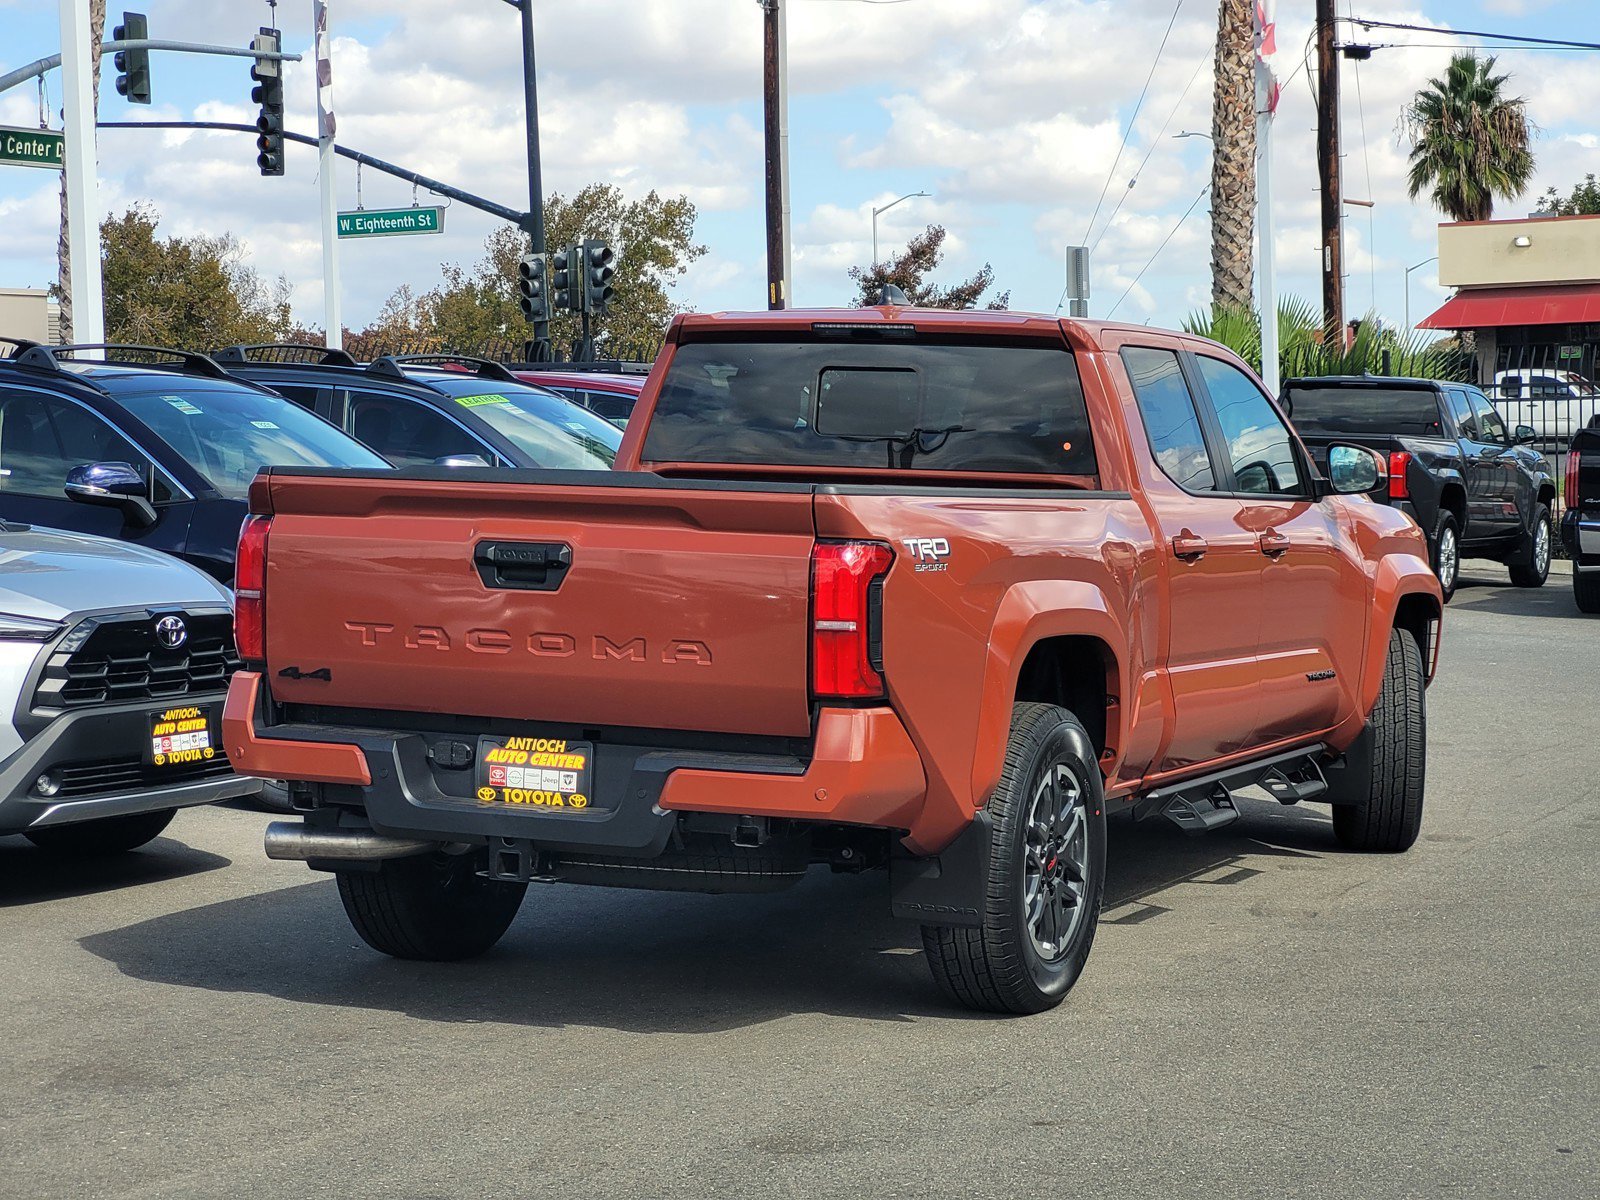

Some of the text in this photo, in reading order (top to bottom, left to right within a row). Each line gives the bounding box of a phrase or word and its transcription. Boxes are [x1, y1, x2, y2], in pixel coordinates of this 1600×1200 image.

[7, 136, 51, 157] Center
[56, 141, 64, 158] D
[340, 214, 432, 233] W. Eighteenth St
[461, 394, 504, 406] LEATHER
[496, 548, 543, 561] TOYOTA
[902, 537, 951, 561] TRD
[914, 562, 949, 572] SPORT
[343, 620, 712, 666] TACOMA
[164, 707, 198, 721] ANTIOCH
[153, 718, 207, 736] AUTO CENTER
[505, 737, 566, 753] ANTIOCH
[168, 749, 202, 763] TOYOTA
[485, 748, 586, 770] AUTO CENTER
[543, 776, 558, 784] Jeep
[502, 788, 564, 806] TOYOTA
